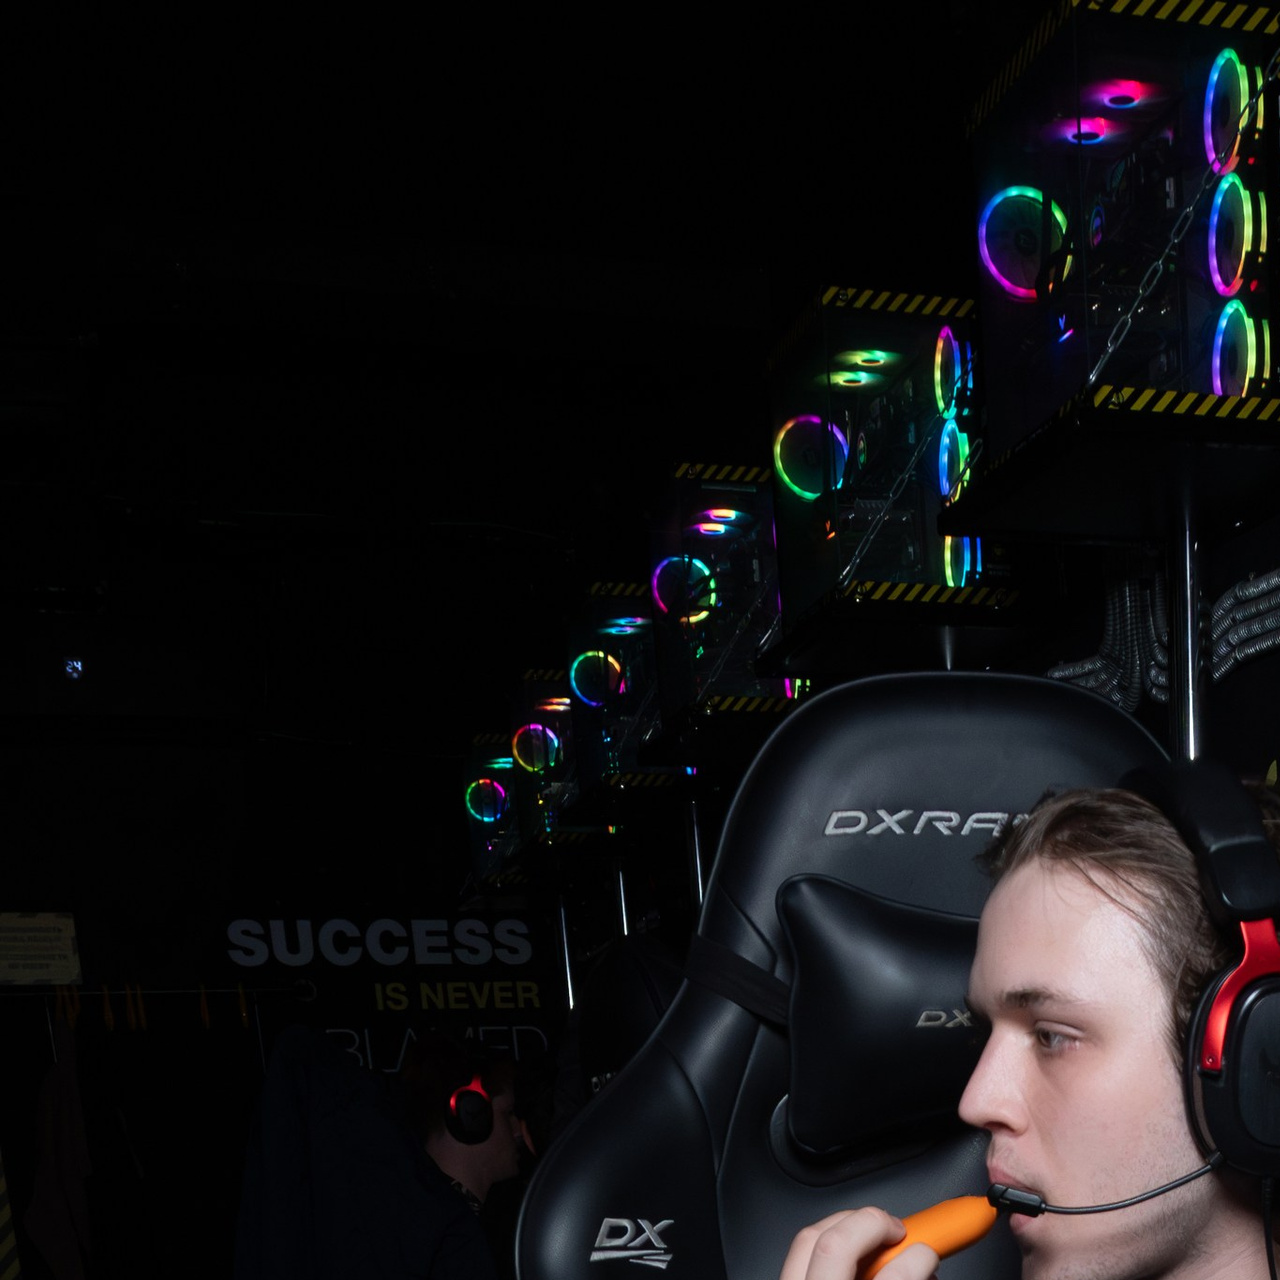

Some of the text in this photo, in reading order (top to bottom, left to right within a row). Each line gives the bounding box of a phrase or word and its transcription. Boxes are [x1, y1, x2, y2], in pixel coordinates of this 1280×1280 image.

[226, 918, 533, 967] SUCCESS
[375, 981, 541, 1011] IS NEVER
[595, 1217, 674, 1250] DX
